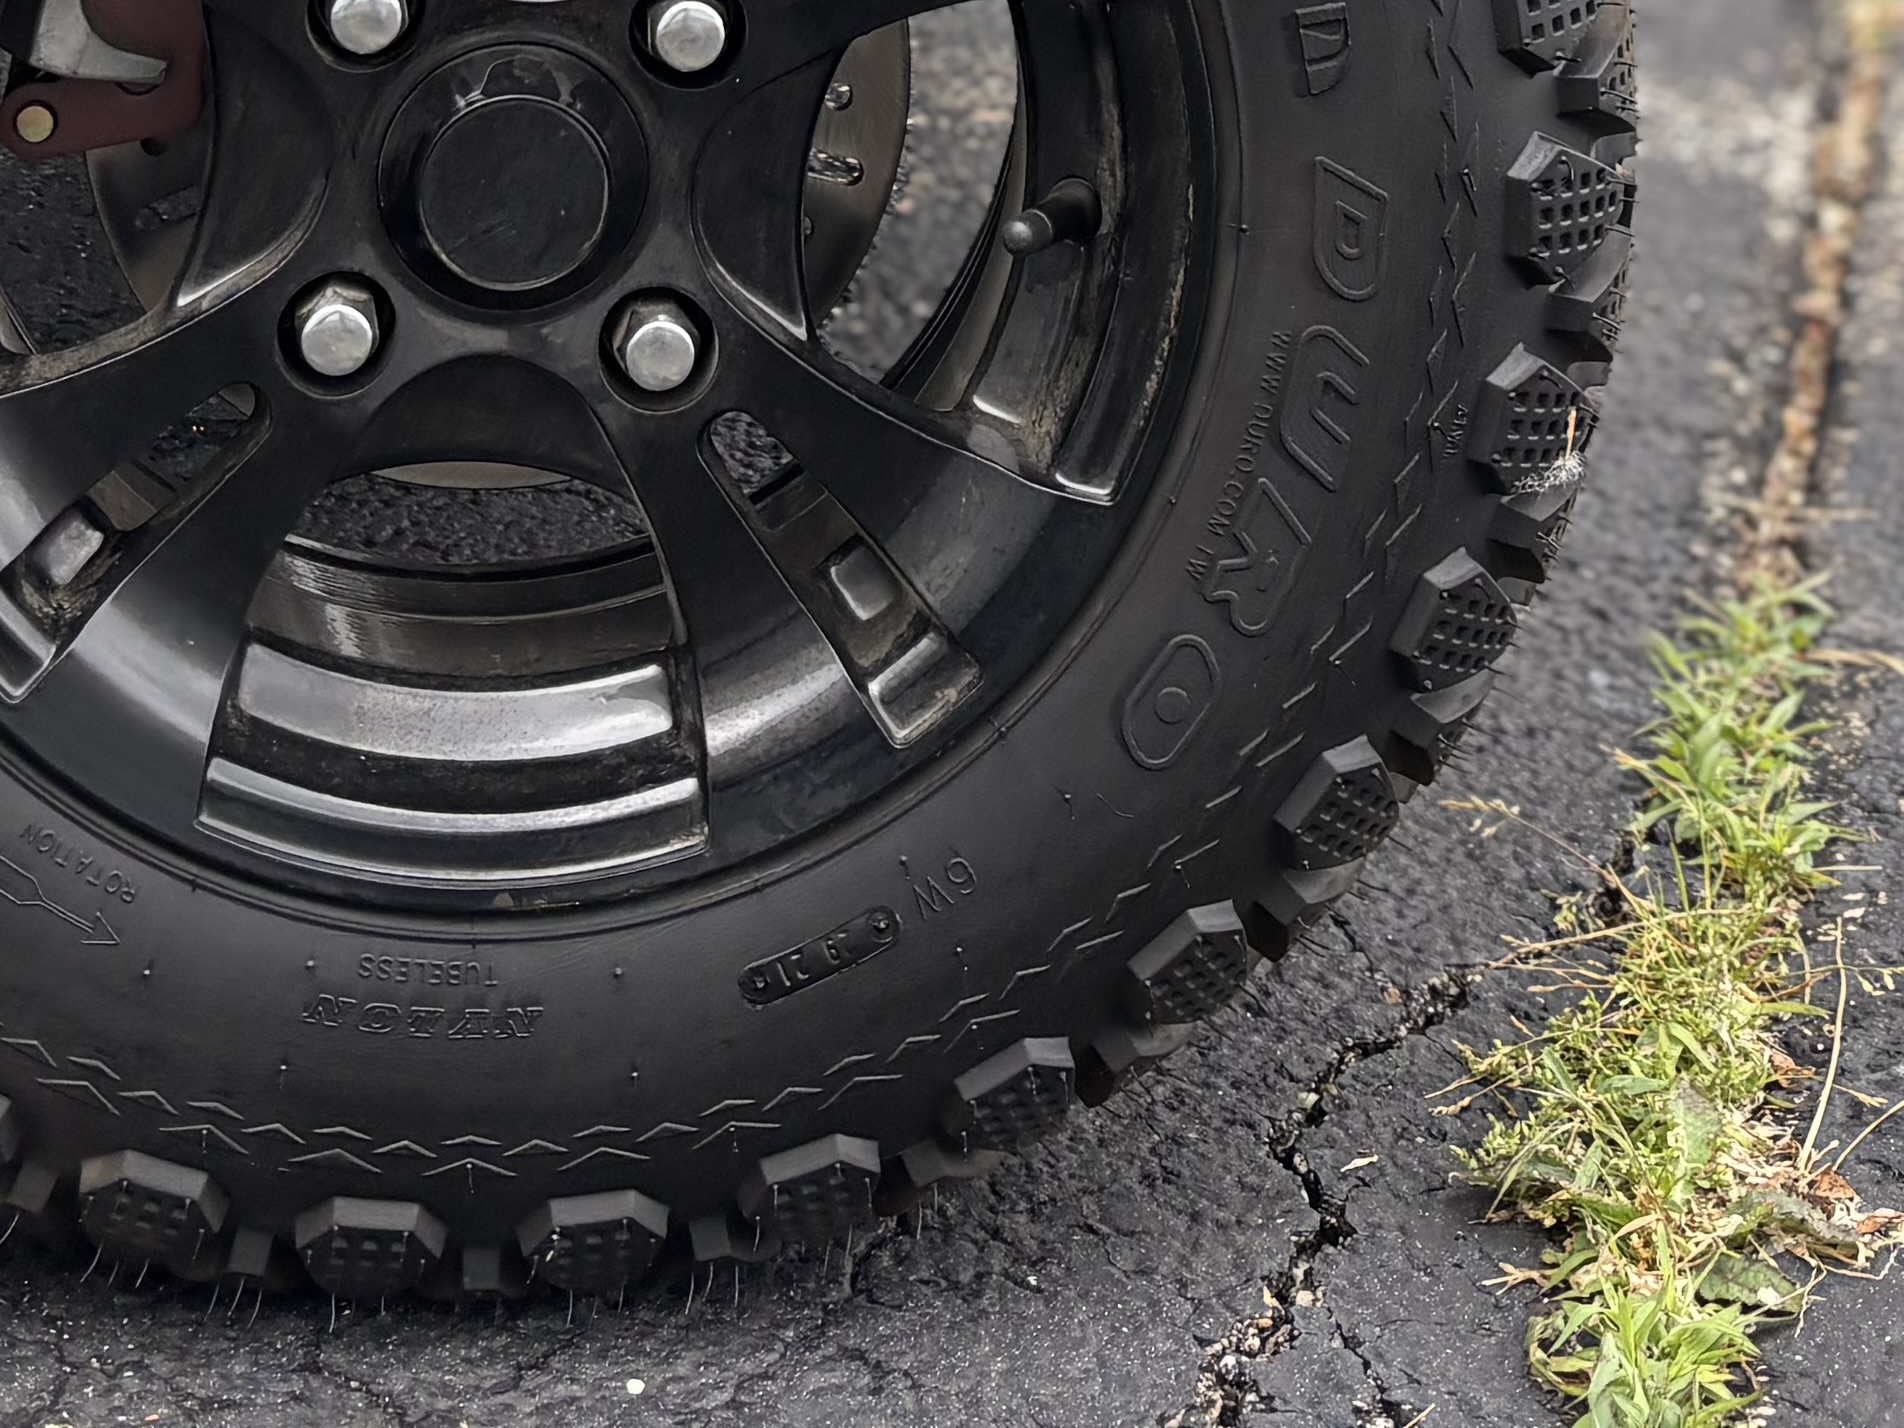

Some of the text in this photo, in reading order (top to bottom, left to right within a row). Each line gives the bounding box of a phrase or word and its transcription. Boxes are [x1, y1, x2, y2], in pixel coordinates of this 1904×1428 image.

[1121, 154, 1390, 770] DURO
[18, 823, 137, 905] ROTATION
[357, 951, 500, 987] TUBELESS
[300, 992, 545, 1041] NYLON
